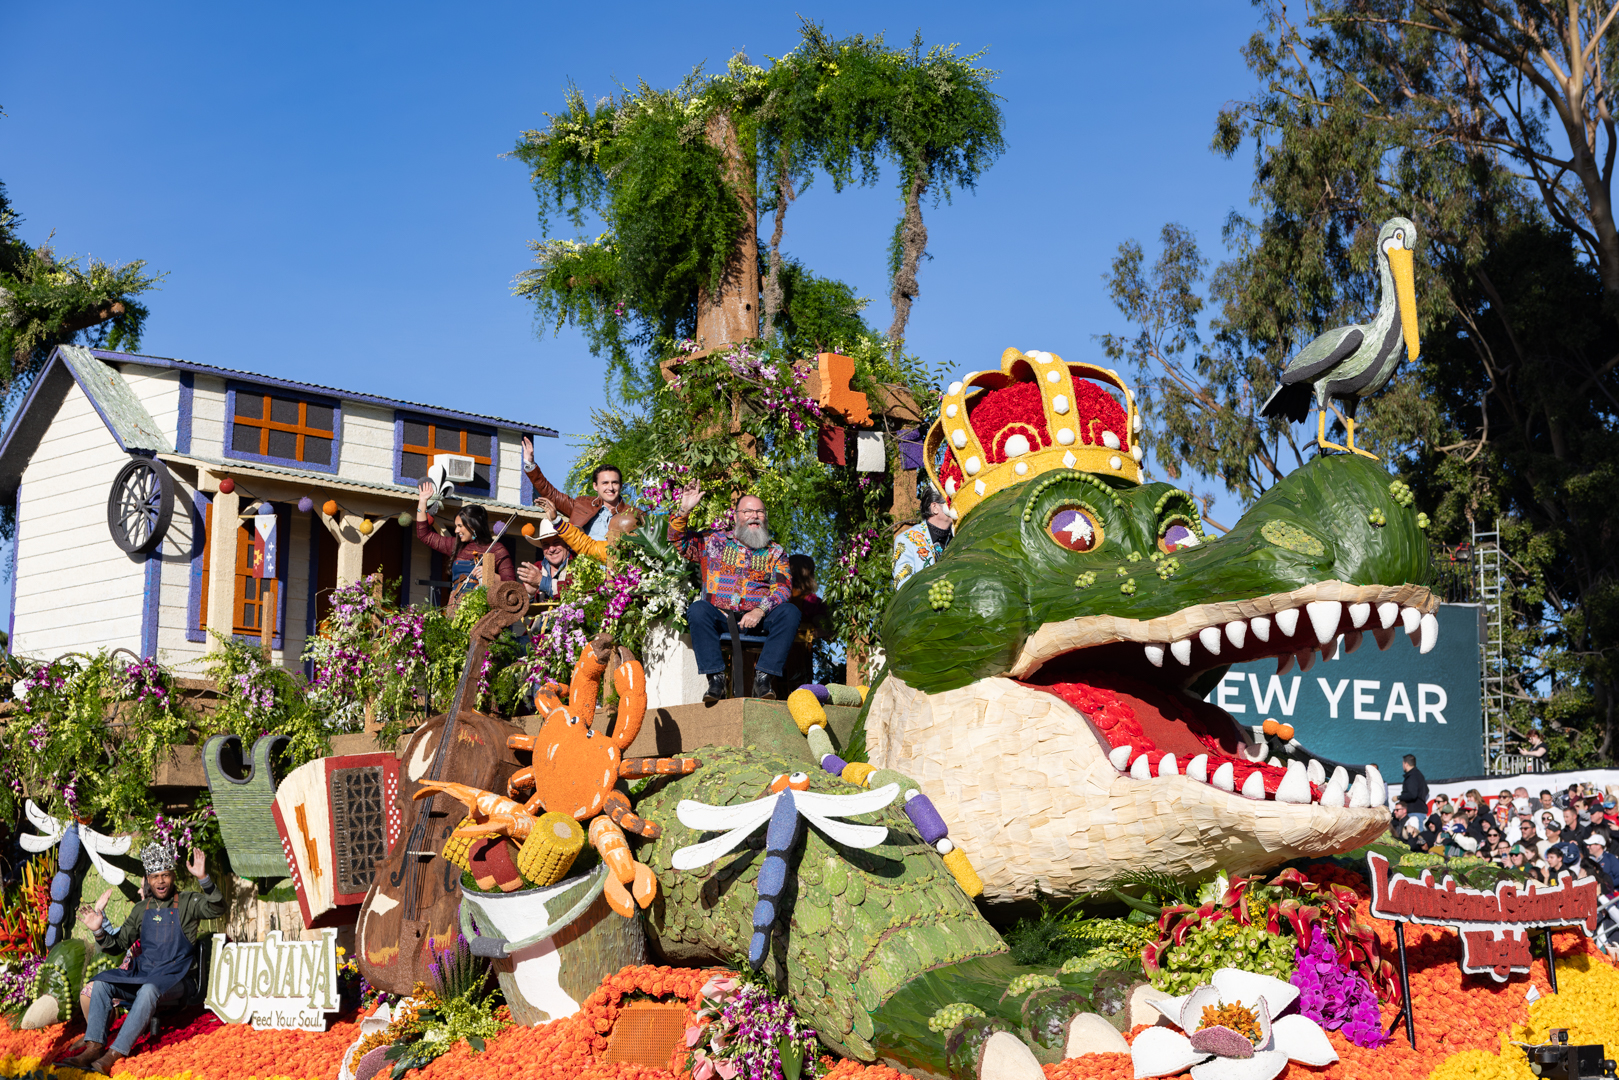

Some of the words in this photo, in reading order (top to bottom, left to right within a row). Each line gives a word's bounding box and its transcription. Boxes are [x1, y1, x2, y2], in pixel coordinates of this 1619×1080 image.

[1203, 671, 1302, 716] EW
[1317, 677, 1448, 724] YEAR
[1372, 856, 1500, 922] Louisiana
[1499, 876, 1598, 931] Saturday
[204, 931, 336, 1024] LOUISIANA
[1464, 929, 1533, 976] Night
[251, 1010, 272, 1027] Feed
[275, 1010, 296, 1027] Your
[298, 1010, 322, 1027] Soul.
